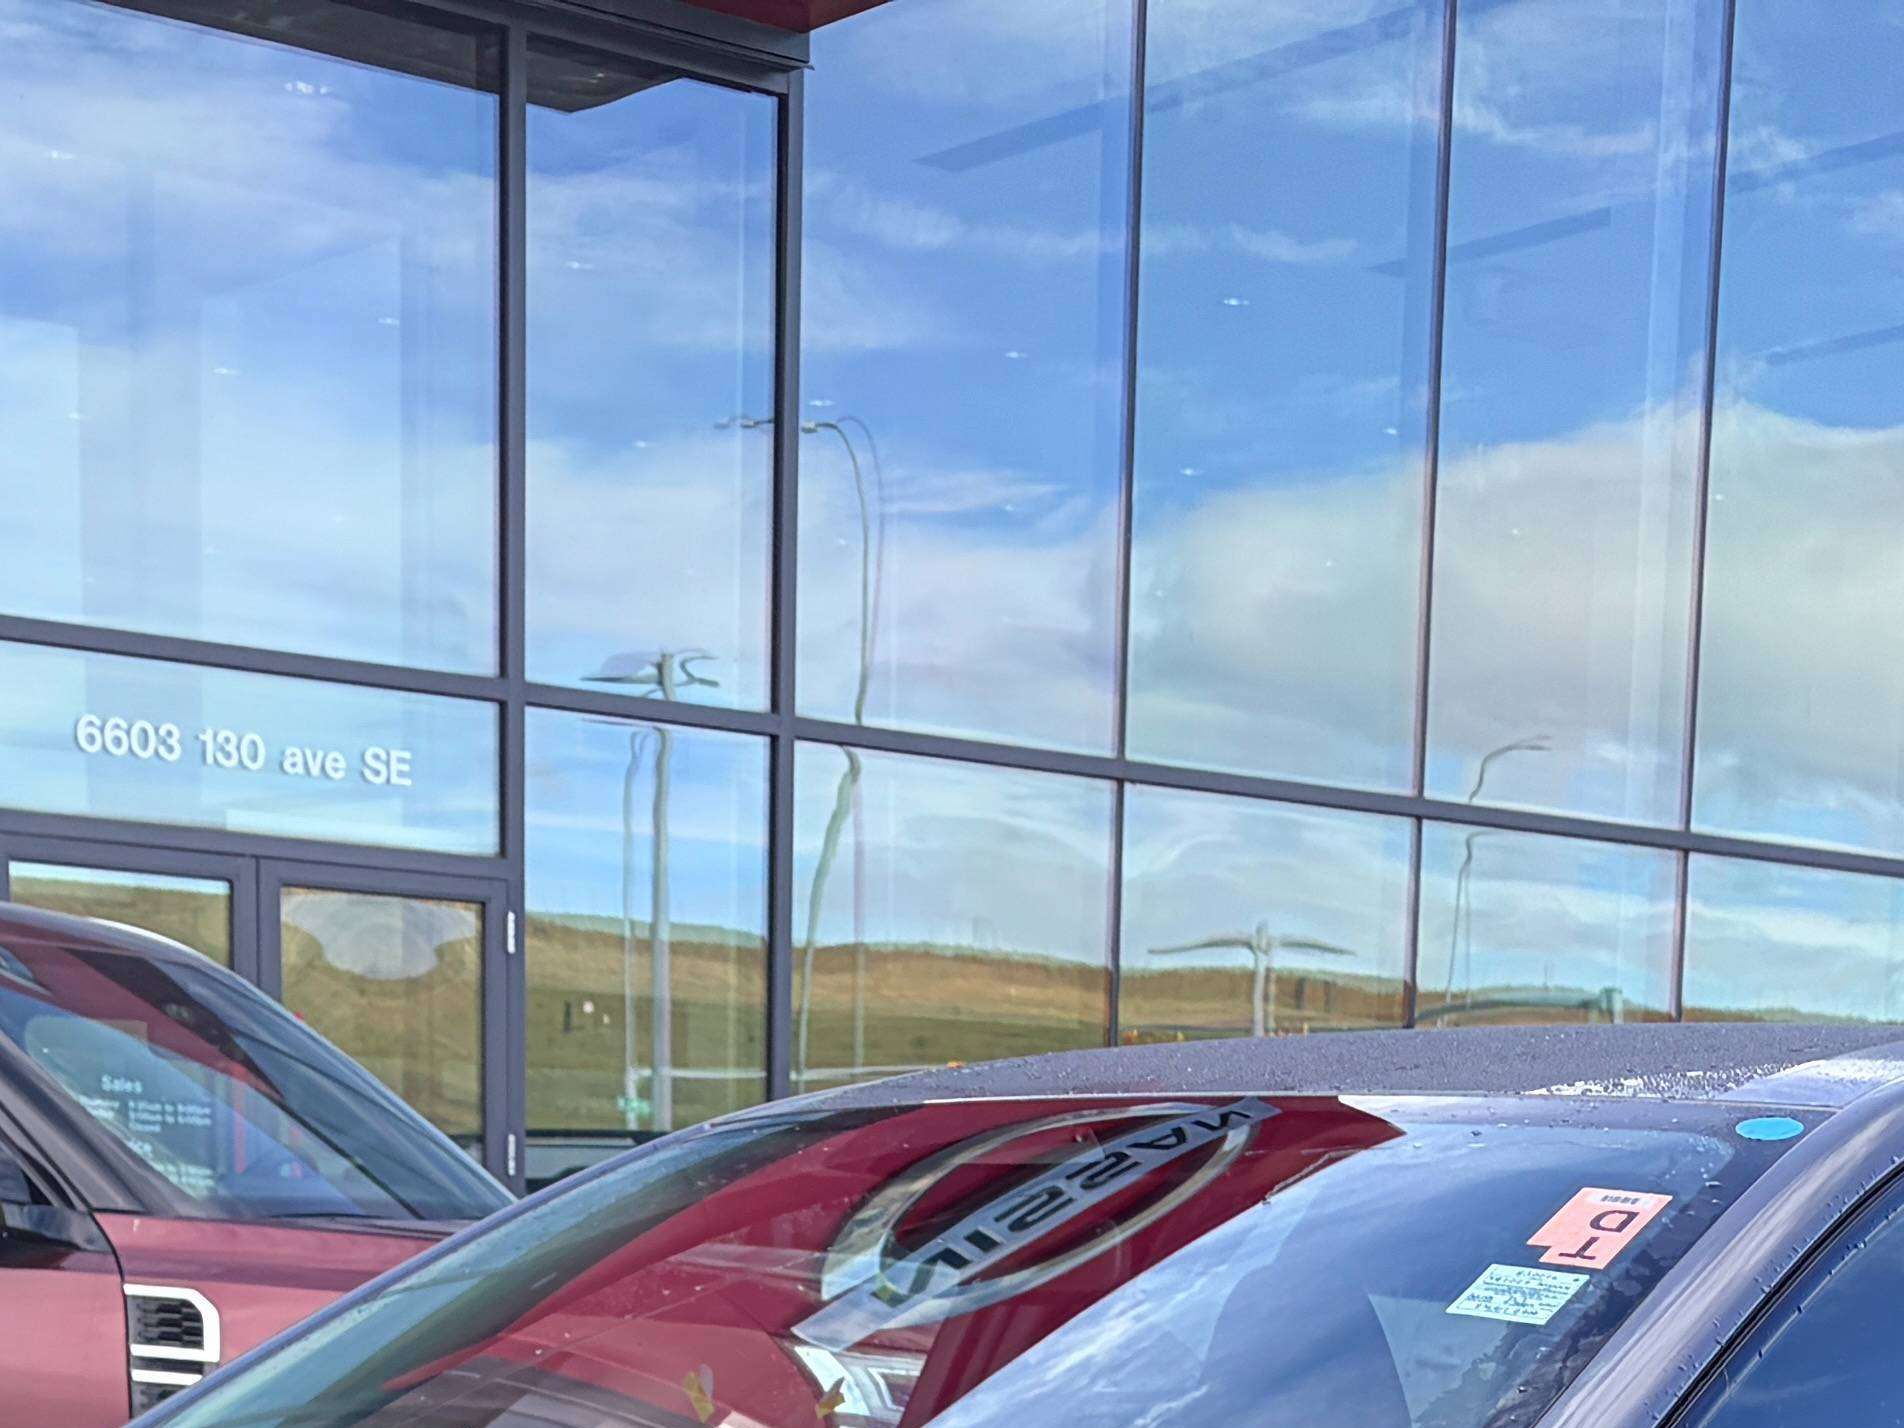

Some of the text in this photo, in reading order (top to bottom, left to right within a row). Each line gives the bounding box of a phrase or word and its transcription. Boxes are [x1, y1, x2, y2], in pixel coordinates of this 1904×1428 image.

[75, 713, 413, 787] 6603 130 ave SE
